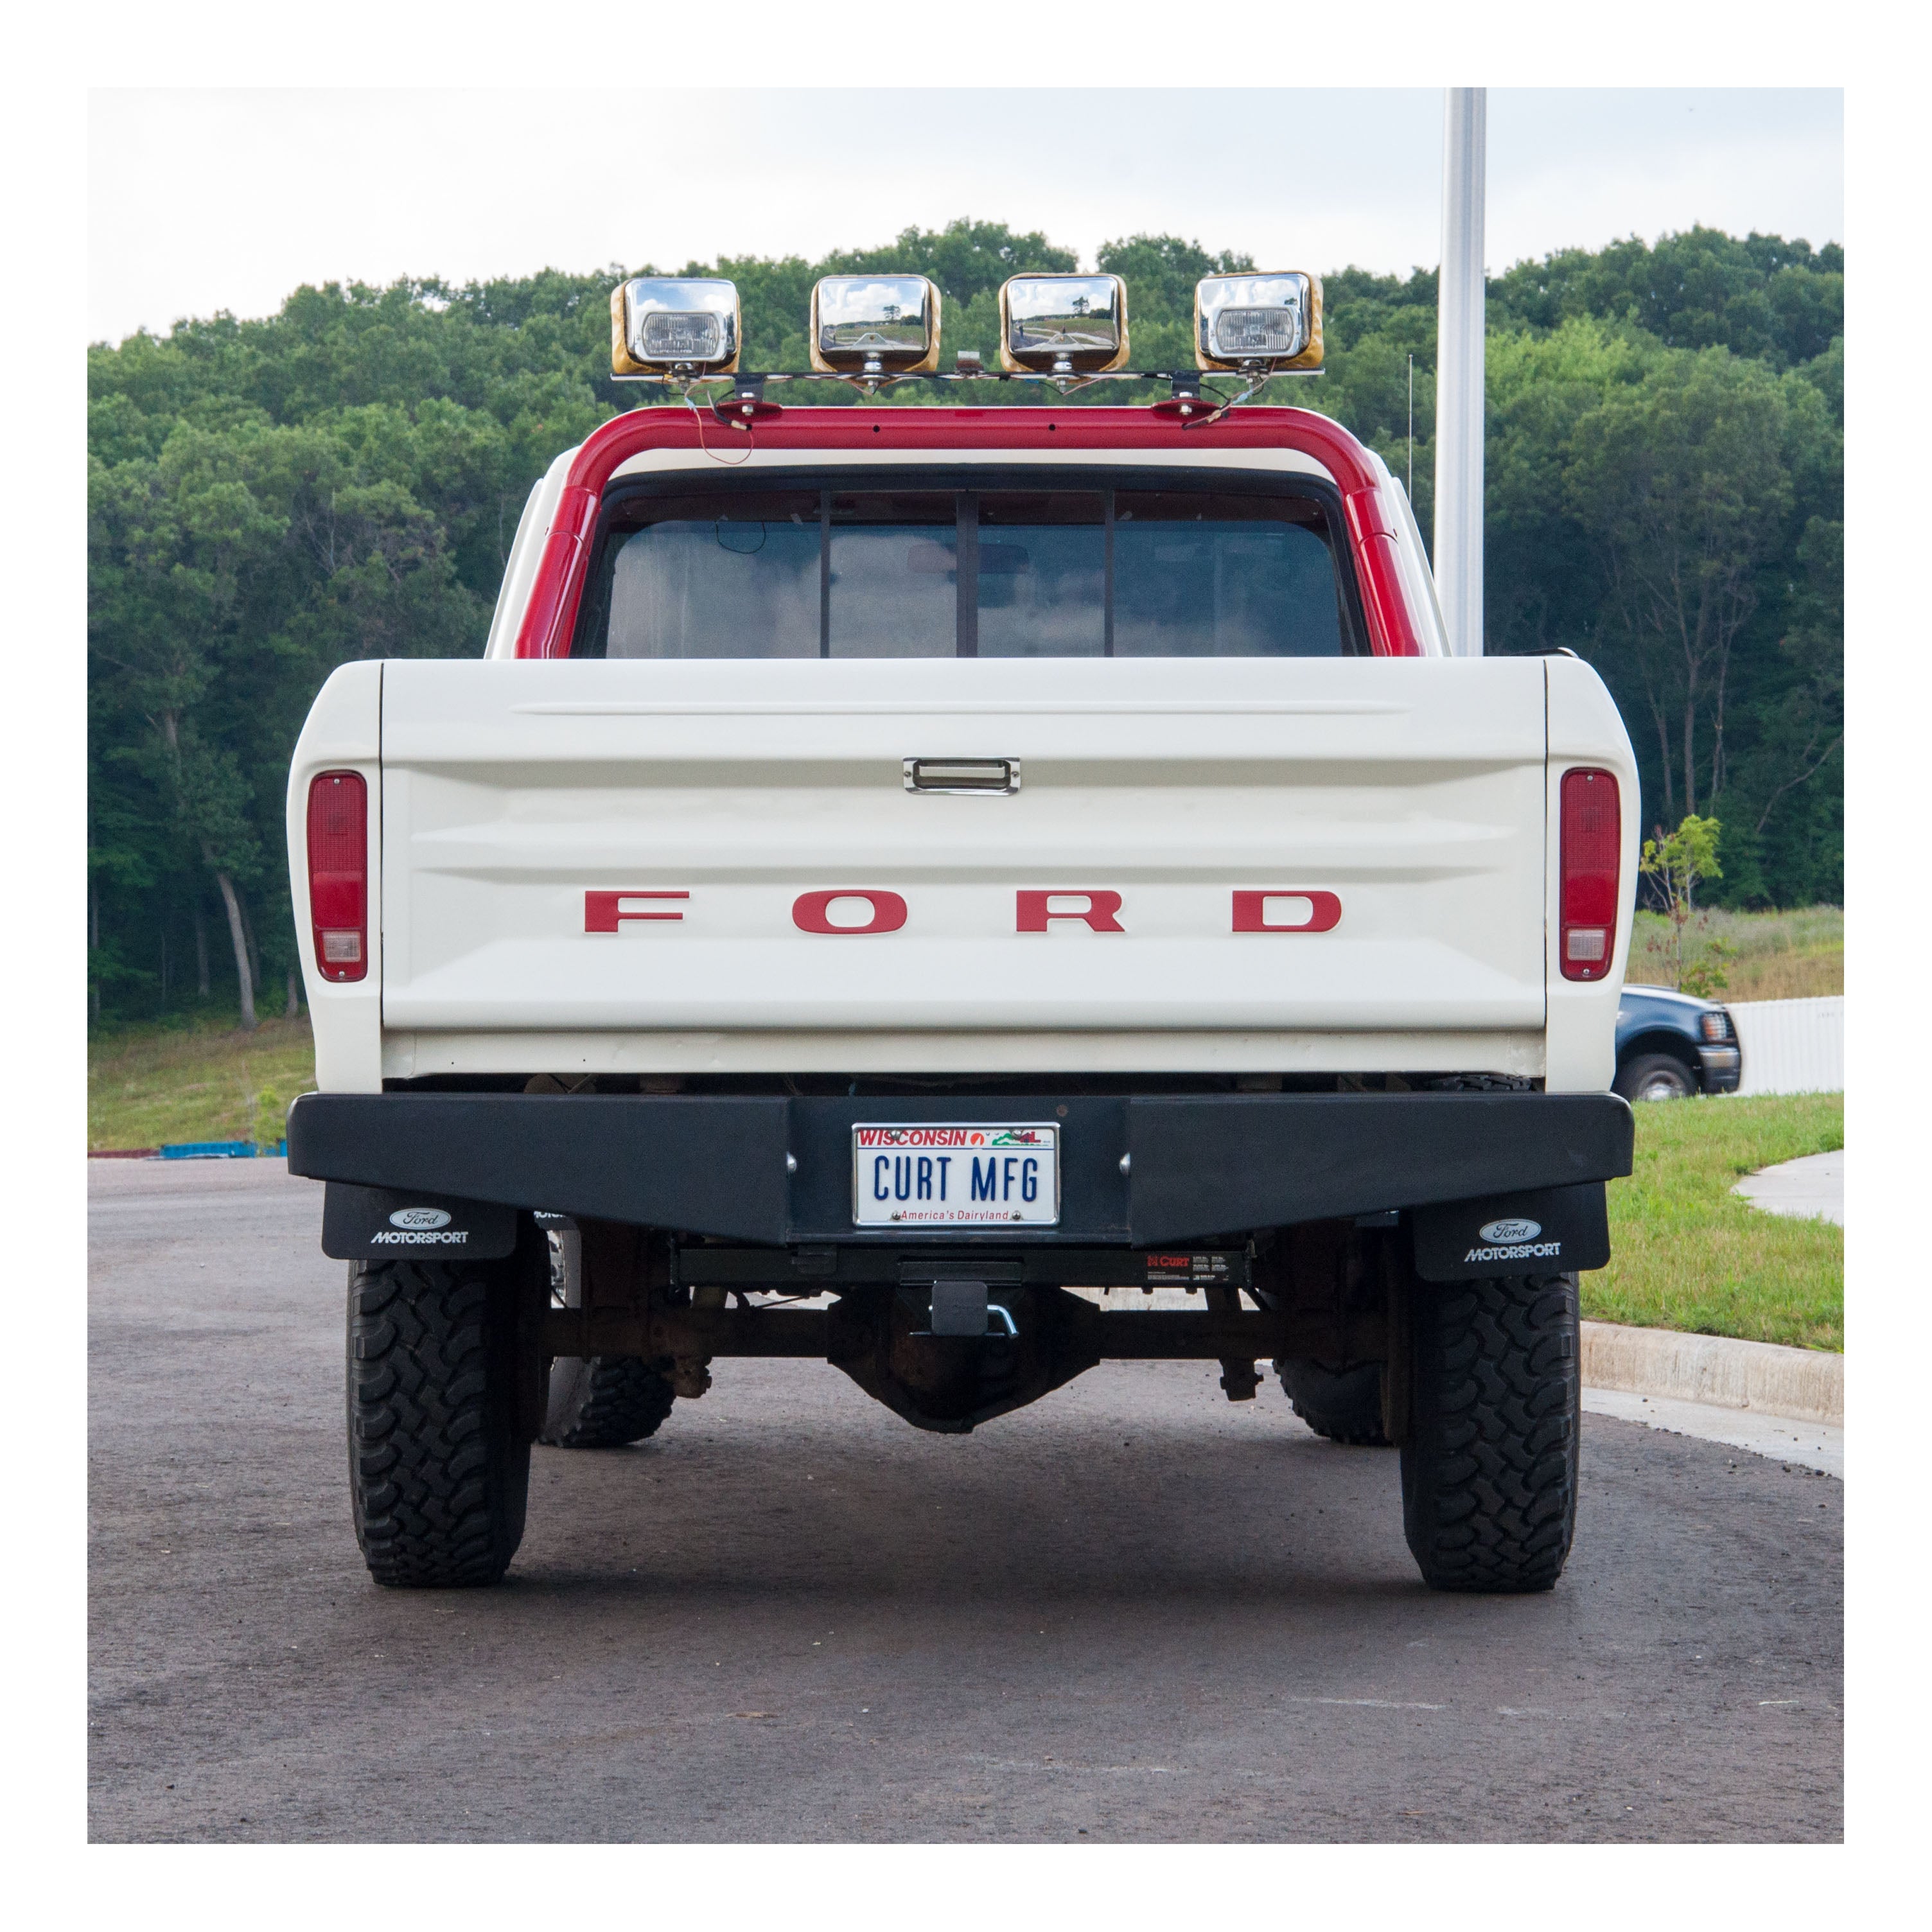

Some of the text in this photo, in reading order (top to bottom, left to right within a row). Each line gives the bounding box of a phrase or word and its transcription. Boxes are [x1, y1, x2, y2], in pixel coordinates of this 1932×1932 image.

[584, 890, 1342, 935] FORD
[859, 1129, 967, 1146] WISCONSIN
[874, 1155, 1038, 1202] CURT MFG
[403, 1211, 439, 1225] Ford
[901, 1210, 1009, 1220] America's Dairyland
[371, 1231, 468, 1244] MOTORSPORT
[1493, 1222, 1528, 1238] Ford
[1464, 1242, 1561, 1262] MOTORSPORT
[1159, 1256, 1190, 1267] CURT
